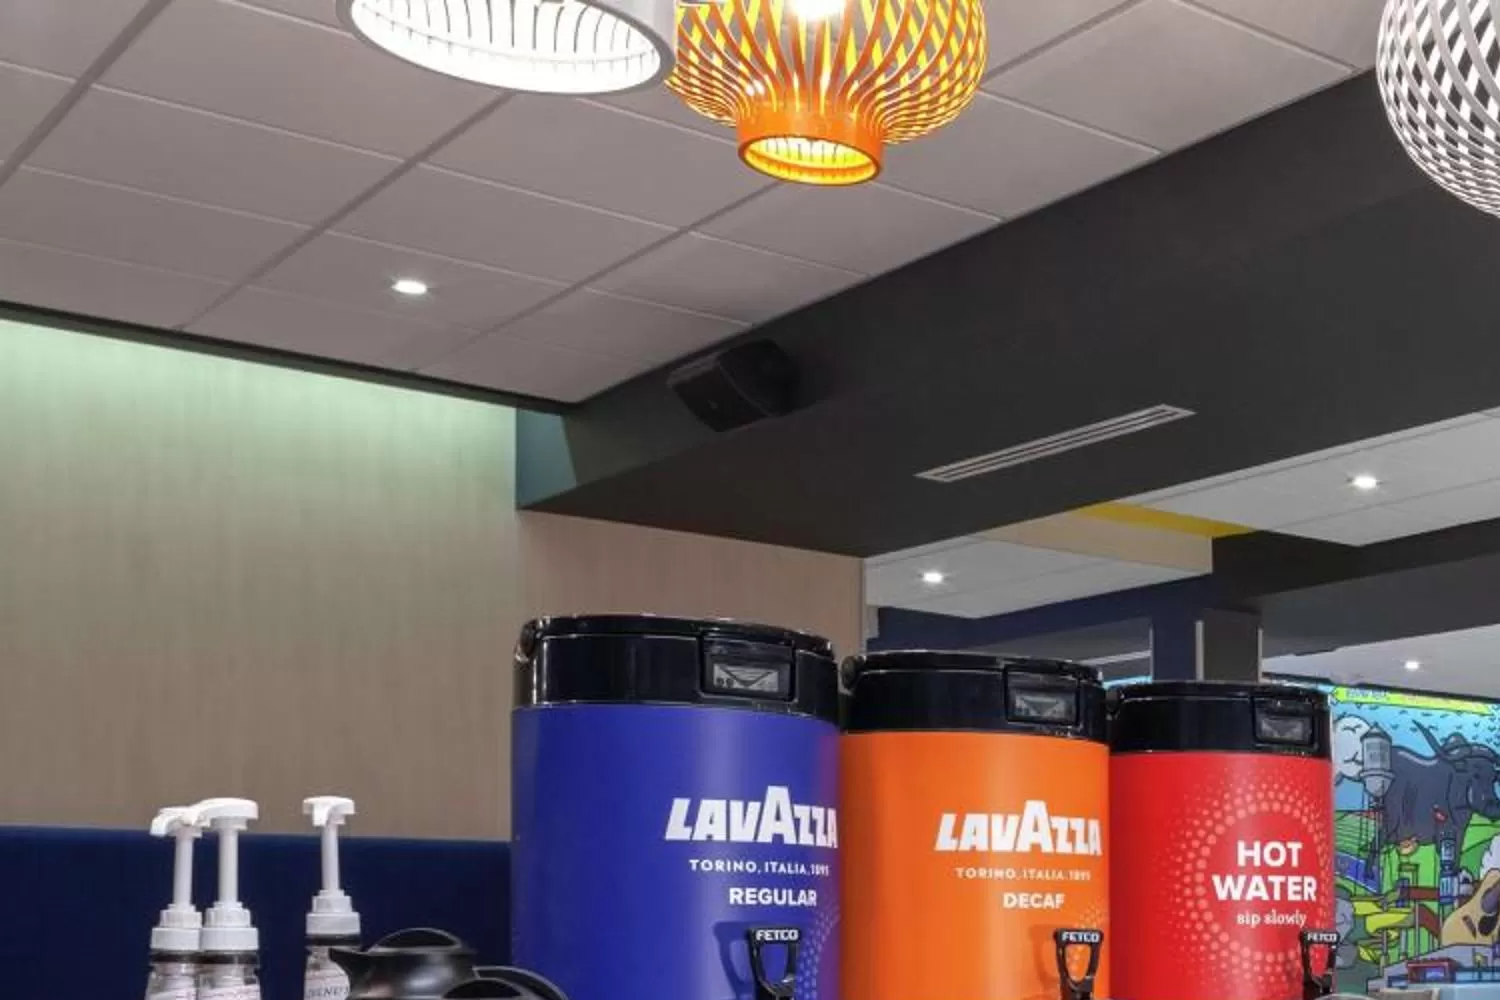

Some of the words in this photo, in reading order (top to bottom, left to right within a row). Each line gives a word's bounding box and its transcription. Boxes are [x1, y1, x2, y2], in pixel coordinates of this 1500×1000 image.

[665, 785, 838, 848] LAVAZZA
[935, 800, 1102, 856] LAVAZZA
[1236, 840, 1303, 868] HOT
[729, 887, 817, 906] REGULAR
[1211, 874, 1318, 902] WATER
[1003, 893, 1065, 909] DECAF
[1236, 911, 1260, 928] sip
[1264, 908, 1307, 928] slowly
[756, 929, 799, 941] FETCO
[1062, 931, 1100, 942] FETCO
[1307, 932, 1337, 941] FETCO
